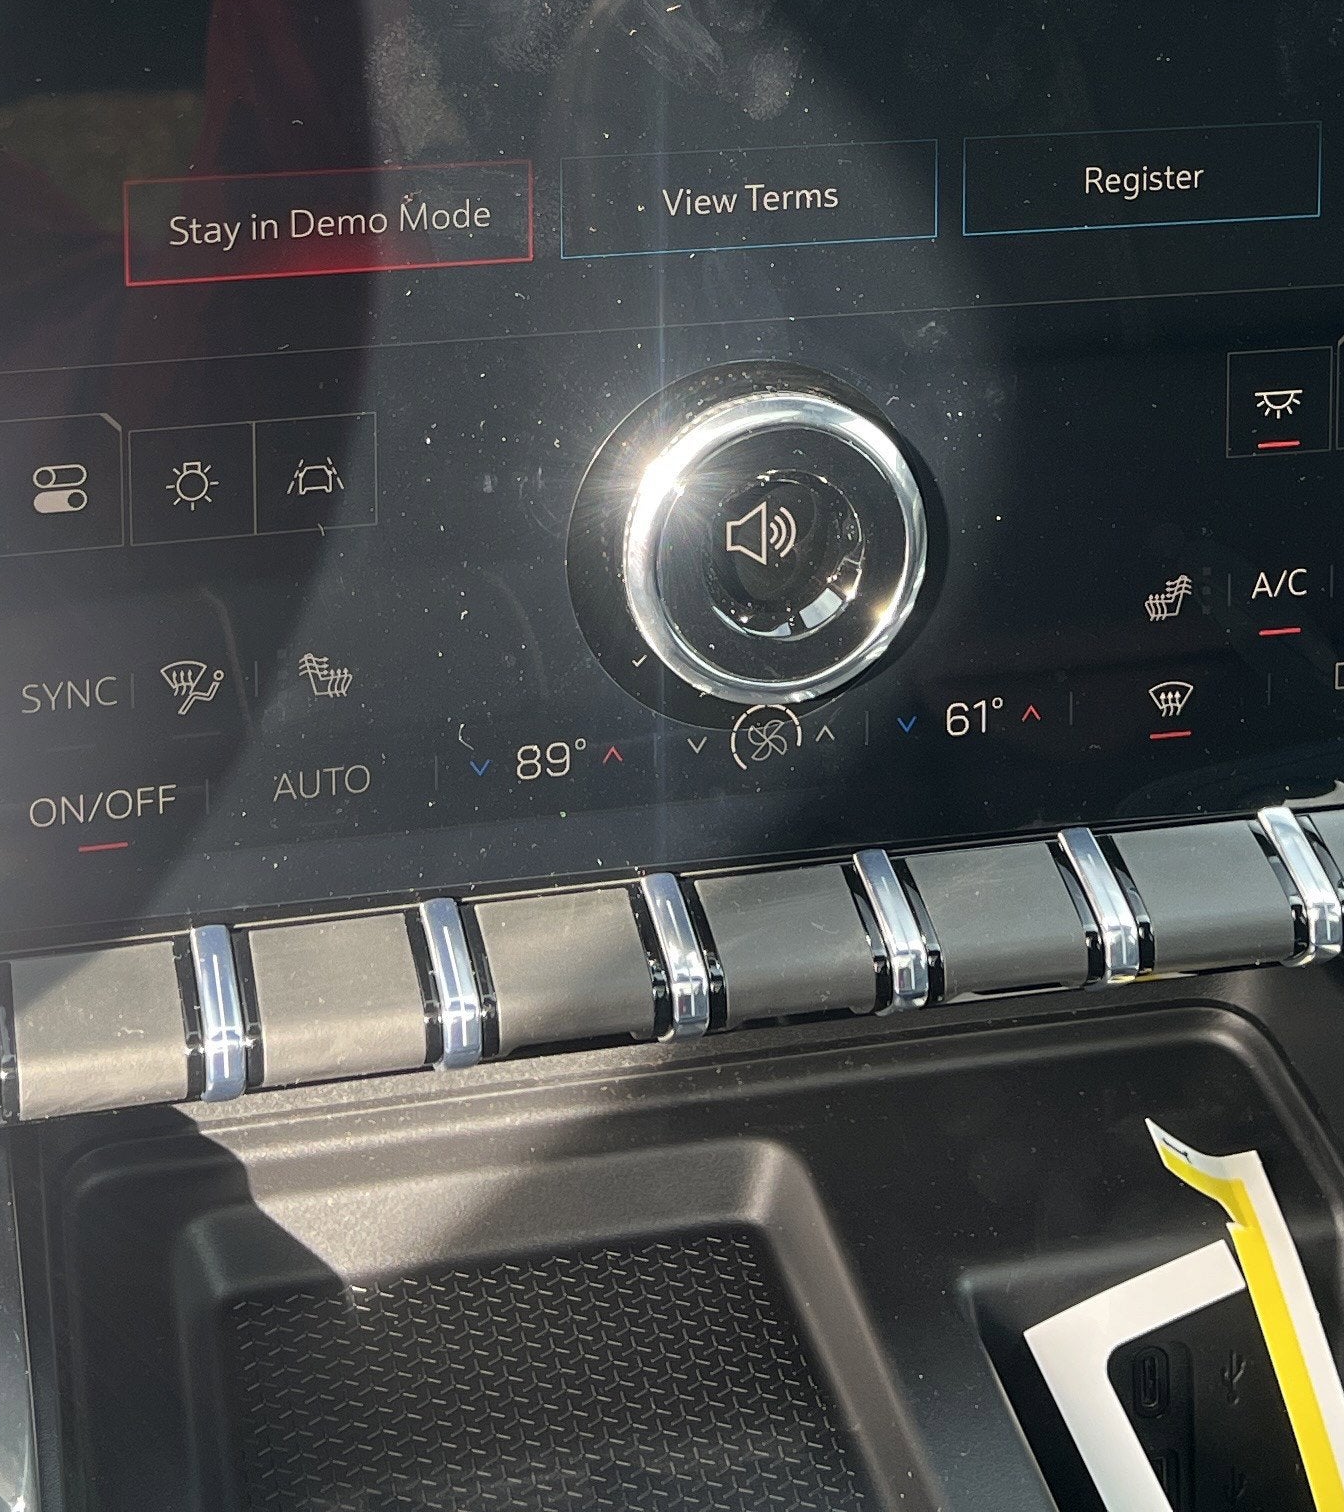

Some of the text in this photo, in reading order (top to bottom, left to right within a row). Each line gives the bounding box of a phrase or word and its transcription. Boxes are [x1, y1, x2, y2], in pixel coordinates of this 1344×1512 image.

[662, 183, 839, 217] View Terms
[1084, 165, 1205, 201] Register
[169, 198, 491, 251] Stay in Demo Mode
[1251, 568, 1308, 599] A/C
[21, 676, 119, 715] SYNC
[273, 764, 372, 801] AUTO
[29, 784, 178, 828] ON/OFF
